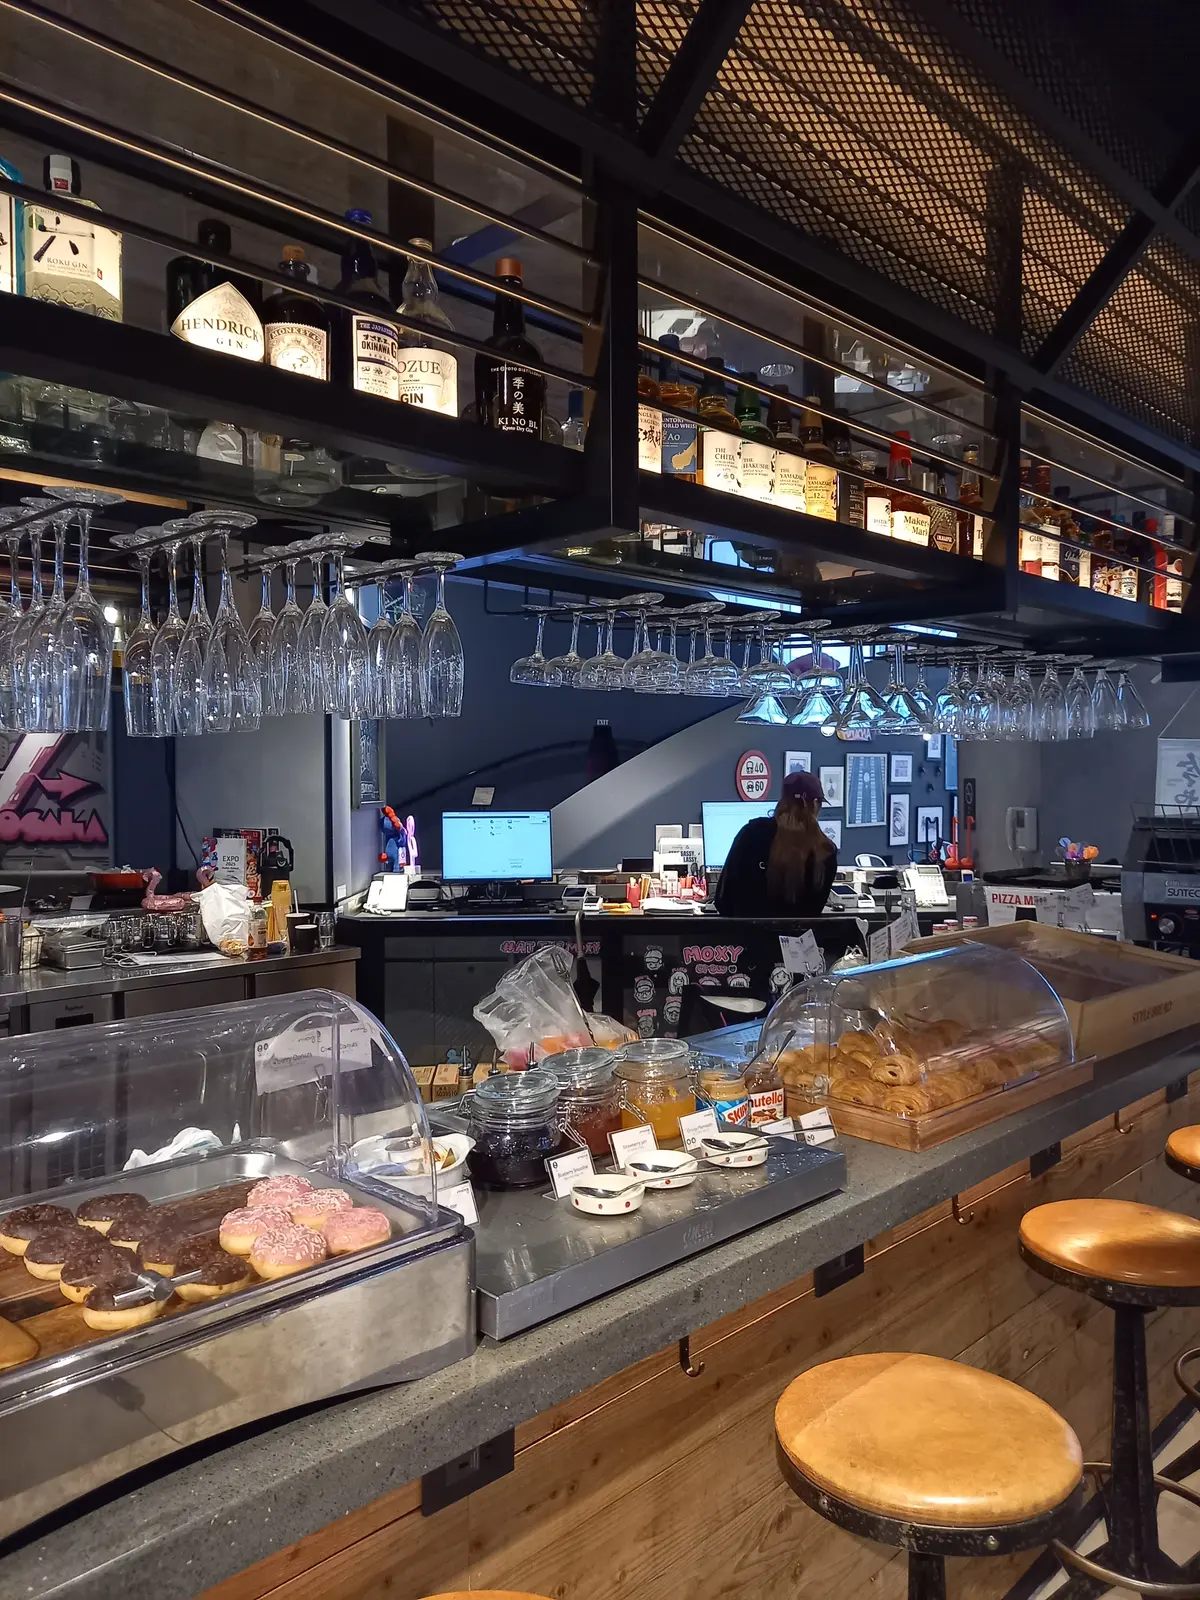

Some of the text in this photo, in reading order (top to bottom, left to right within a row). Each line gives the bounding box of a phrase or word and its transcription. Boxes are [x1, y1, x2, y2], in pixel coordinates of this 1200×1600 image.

[46, 257, 70, 267] ROKU
[181, 318, 262, 343] HENDRICK
[271, 326, 321, 341] MONKEY 47
[216, 336, 243, 349] GIN
[361, 340, 397, 359] OKINAWA G
[397, 360, 442, 375] OZUE
[400, 393, 424, 404] GIN
[512, 377, 525, 415] 季の美
[638, 411, 653, 419] NGLE
[498, 417, 509, 426] KI
[512, 417, 526, 426] NO
[715, 453, 735, 461] CHITA
[755, 763, 764, 773] 40
[755, 781, 764, 791] 60
[992, 893, 1034, 905] PIZZA M
[682, 945, 743, 965] MOXY
[747, 1091, 784, 1107] nutella
